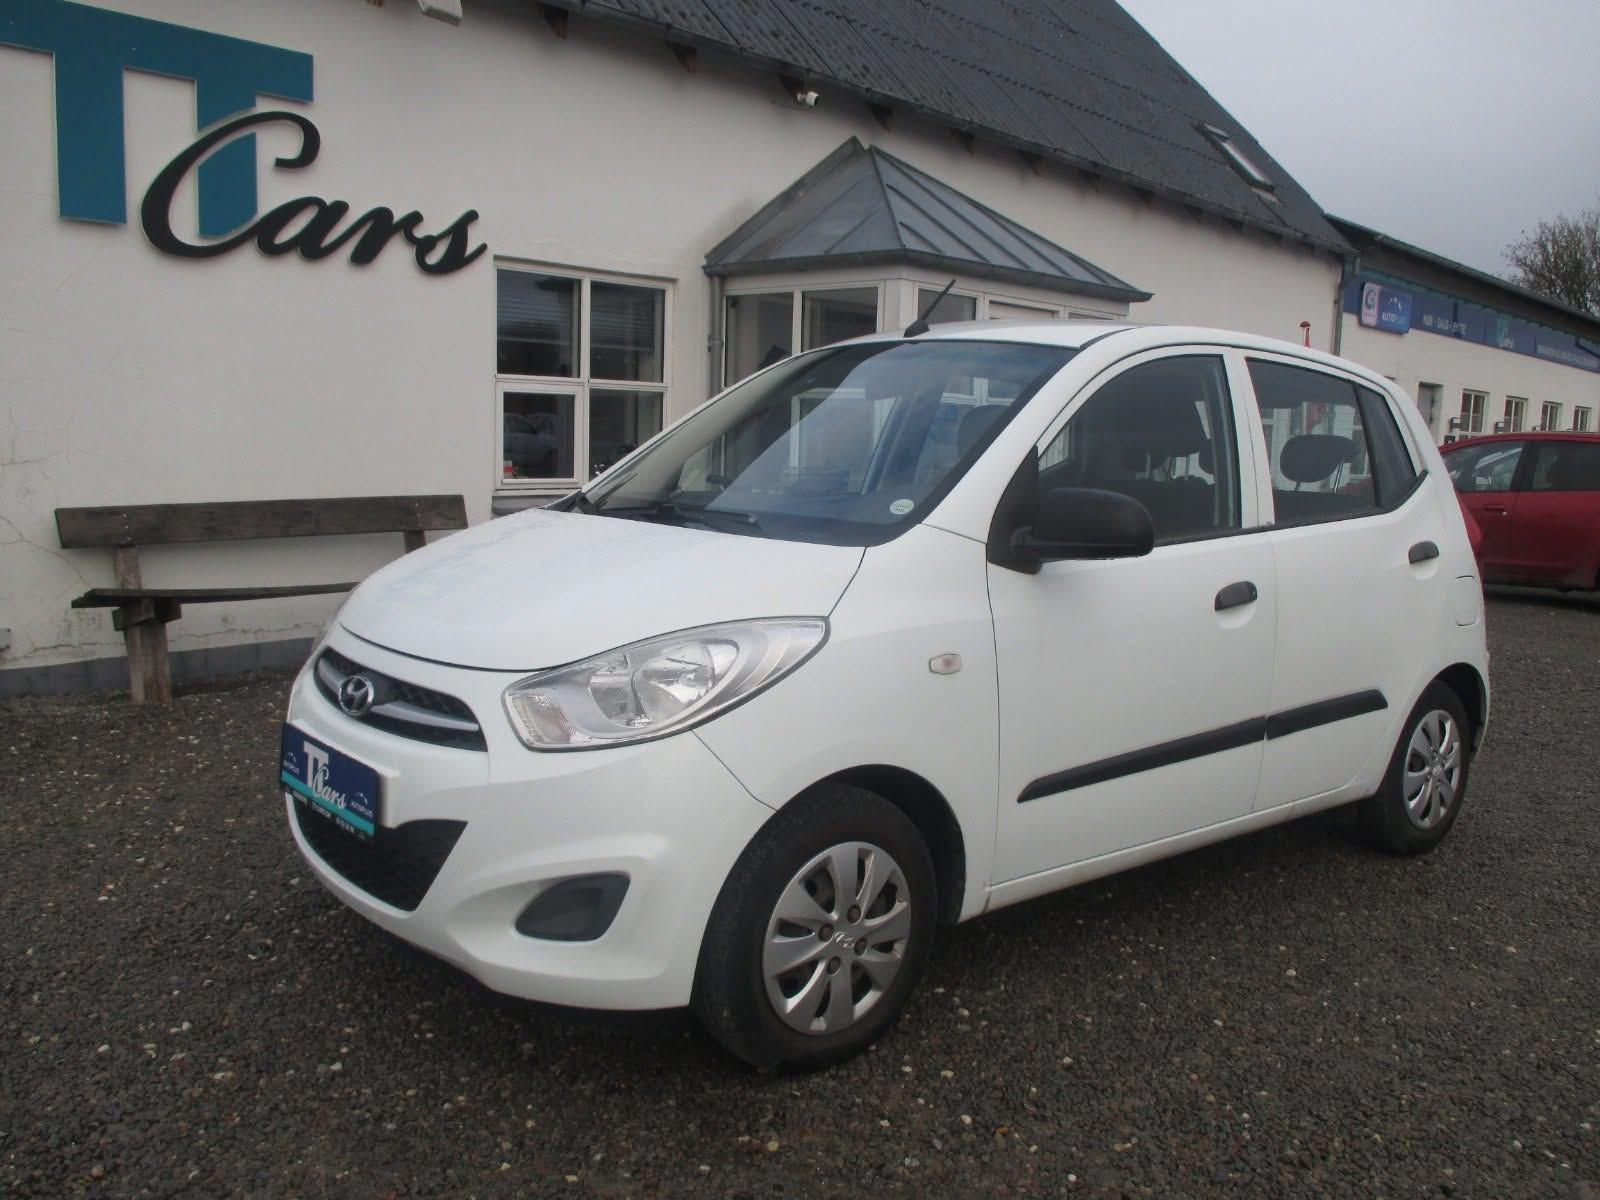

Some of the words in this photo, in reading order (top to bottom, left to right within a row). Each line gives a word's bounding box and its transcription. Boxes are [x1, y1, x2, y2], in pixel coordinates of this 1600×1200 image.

[0, 0, 314, 237] TT
[141, 110, 487, 275] Cars
[312, 766, 347, 810] Cars
